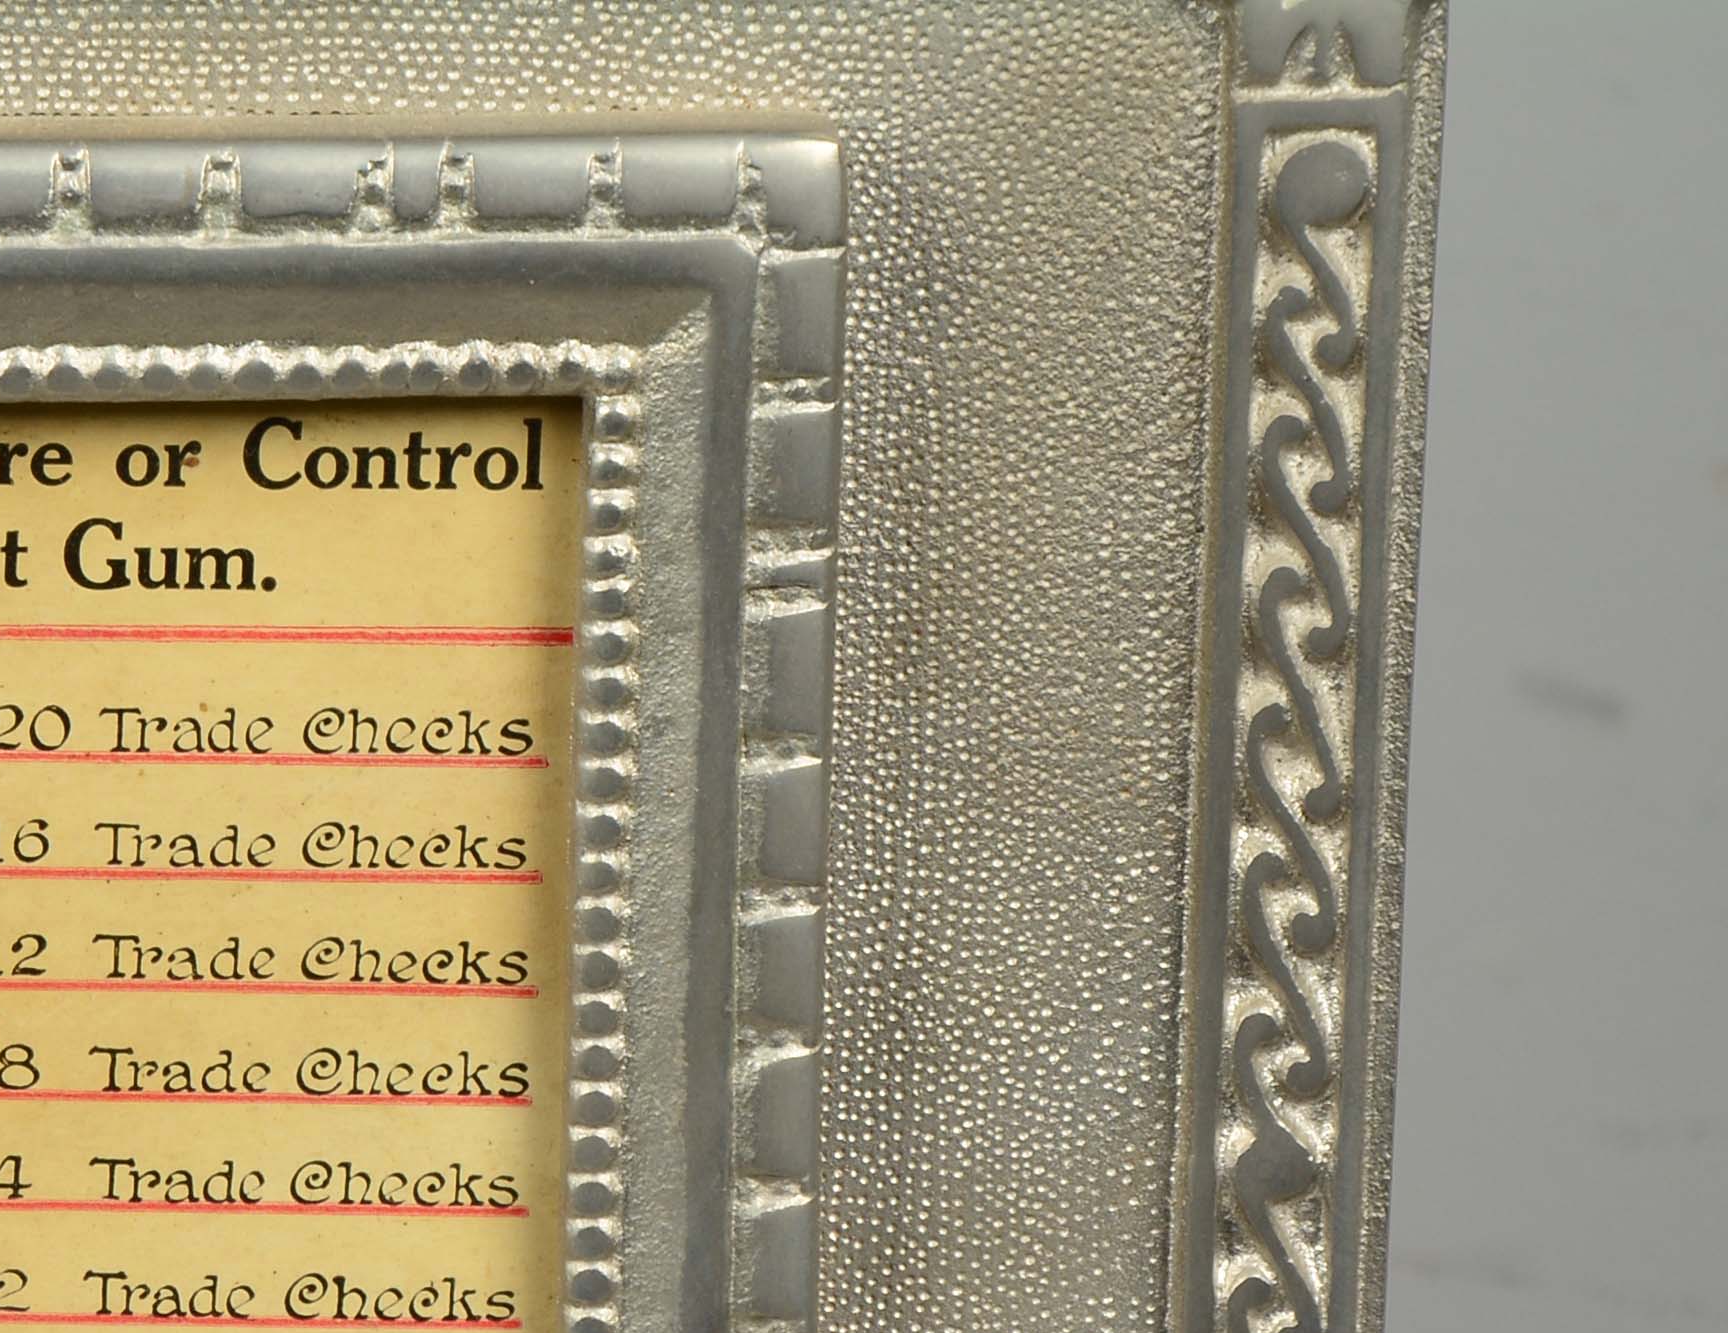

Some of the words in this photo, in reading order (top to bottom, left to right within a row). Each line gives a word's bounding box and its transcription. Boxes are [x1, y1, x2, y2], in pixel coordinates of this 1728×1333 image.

[115, 439, 202, 488] or
[242, 413, 545, 491] Control
[63, 517, 277, 592] Gum.
[99, 707, 274, 754] Trade
[302, 707, 534, 757] Checks
[94, 822, 276, 868] Trade
[302, 822, 527, 870] Checks
[92, 934, 275, 981] Trade
[301, 936, 529, 986] Checks
[88, 1045, 271, 1093] Trade
[296, 1047, 530, 1098] Checks
[89, 1157, 265, 1204] Trade
[290, 1160, 519, 1209] Checks
[83, 1270, 255, 1319] Trade
[284, 1272, 515, 1322] Checks
